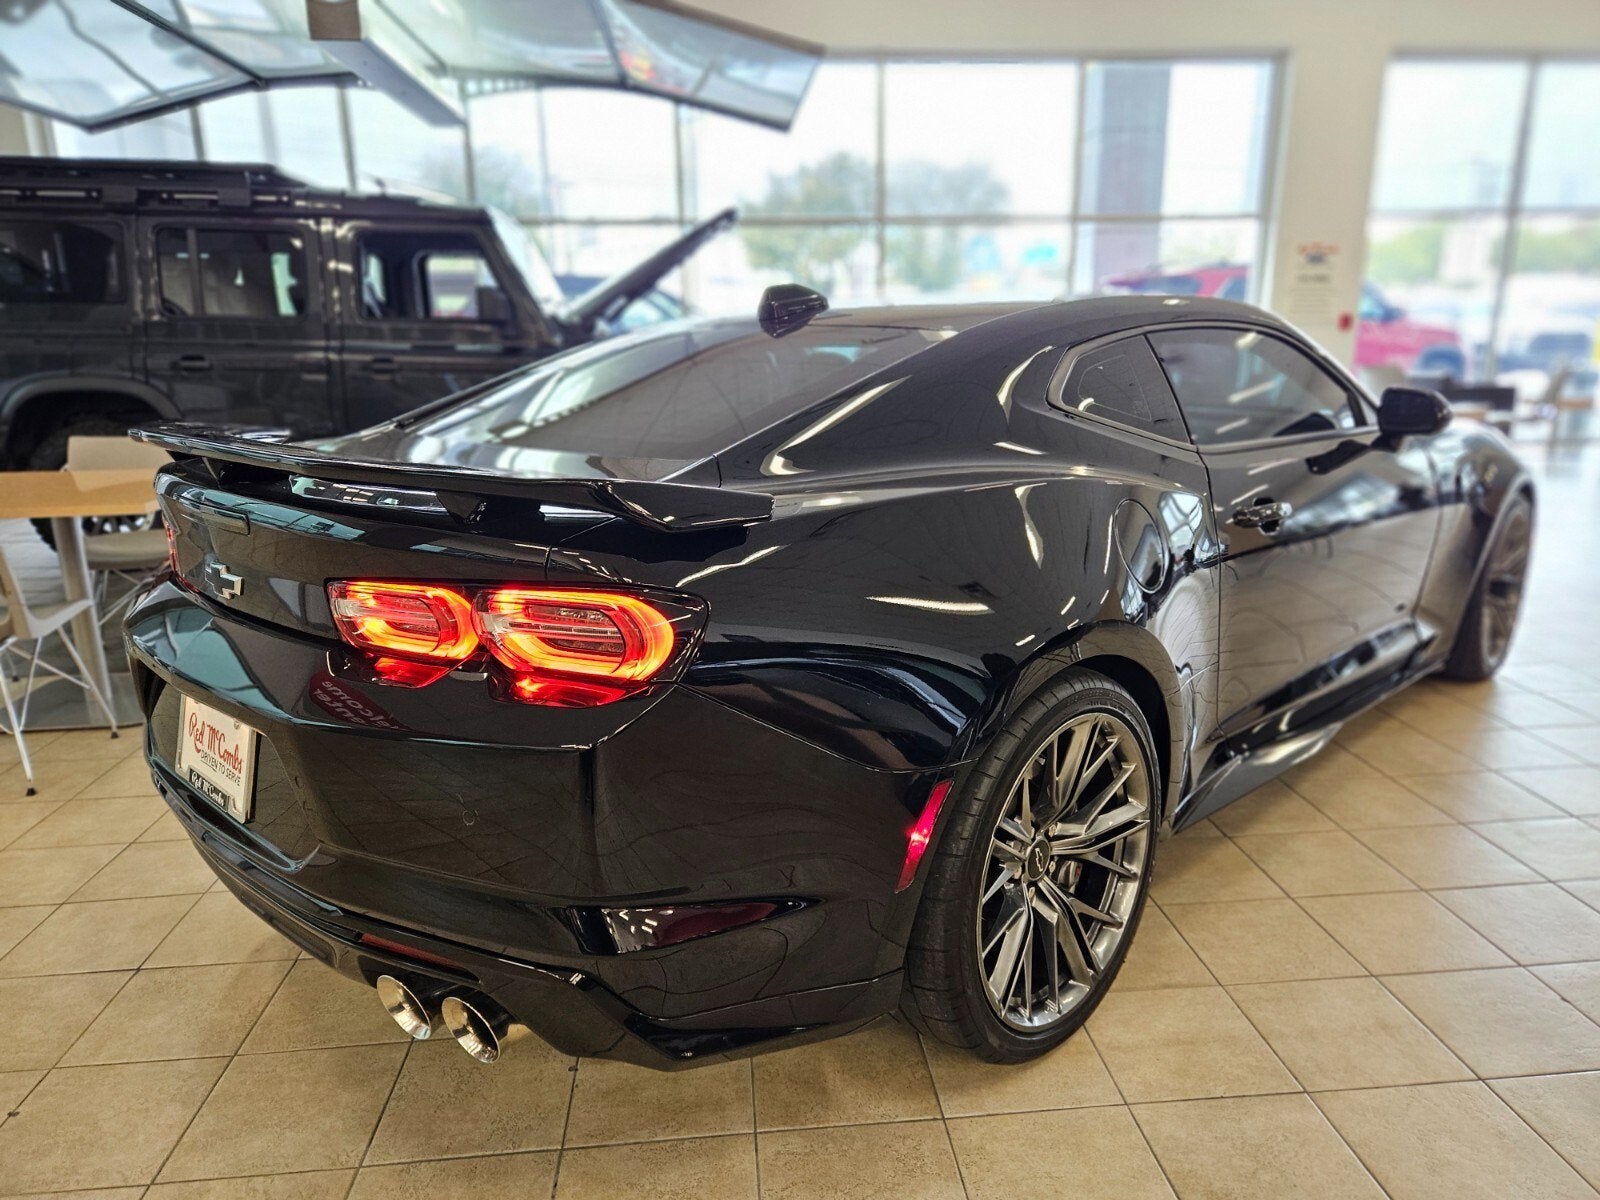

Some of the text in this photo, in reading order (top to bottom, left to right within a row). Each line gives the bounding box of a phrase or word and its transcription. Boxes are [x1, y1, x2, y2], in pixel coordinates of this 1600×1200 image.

[188, 712, 205, 754] Red
[200, 749, 241, 787] DRIVEN TO SERVE
